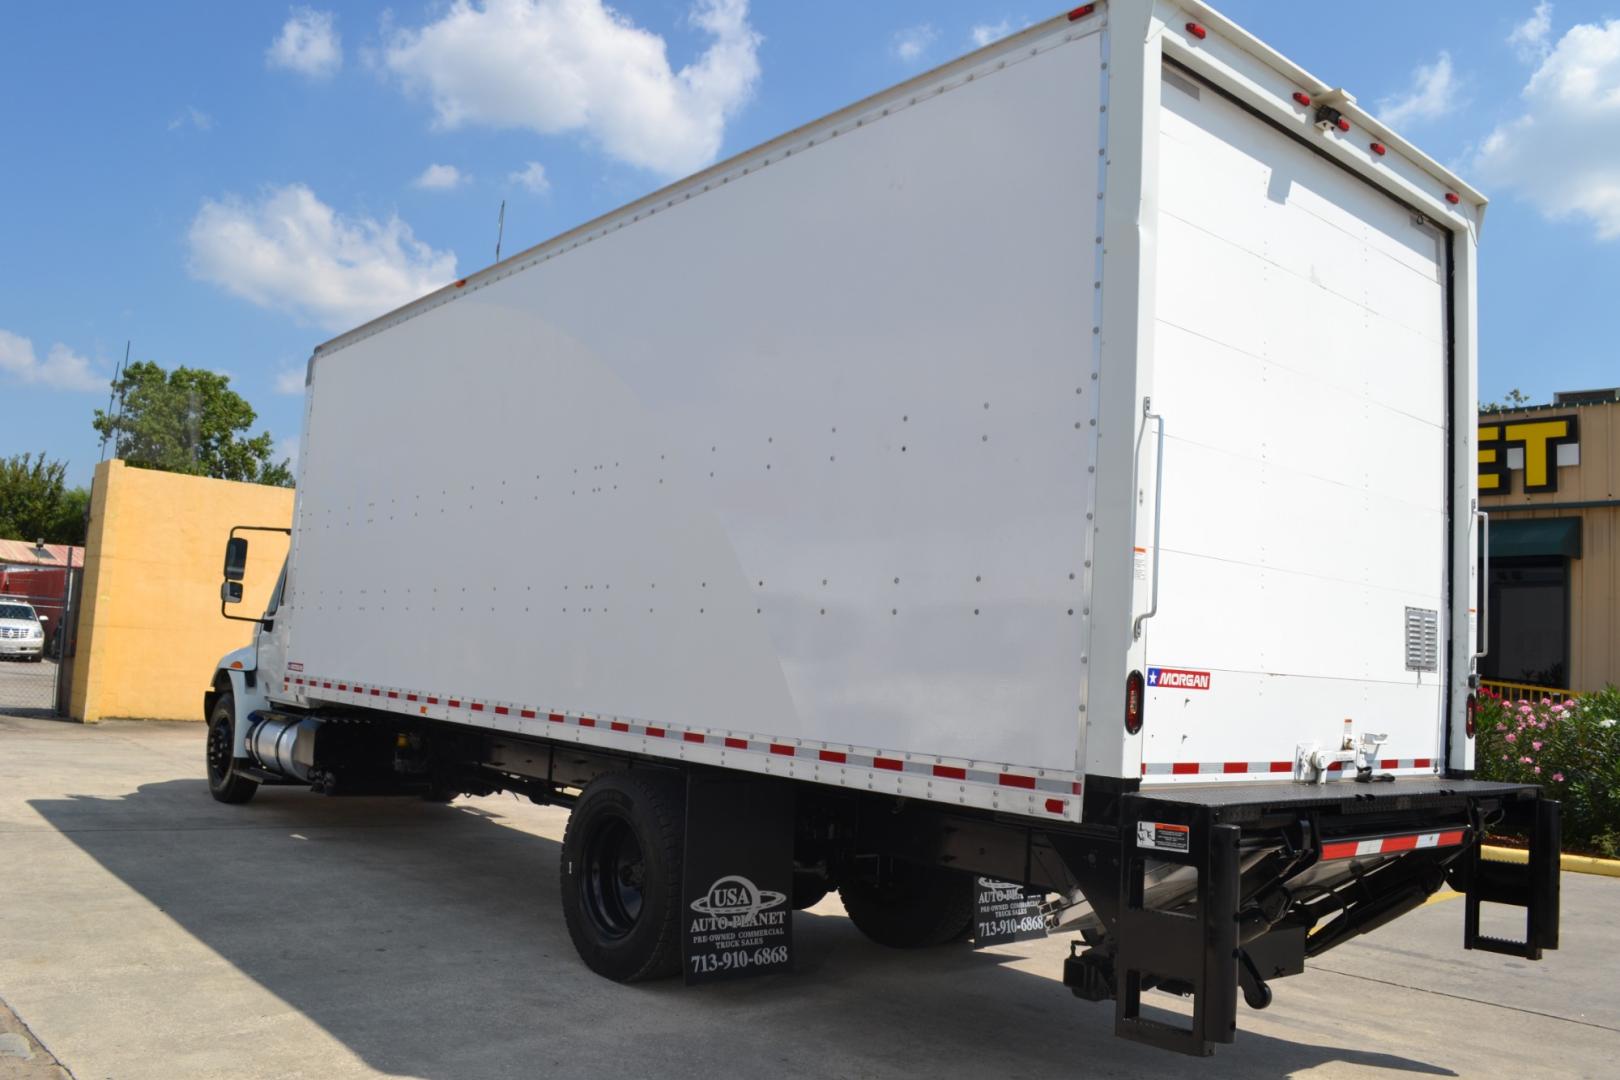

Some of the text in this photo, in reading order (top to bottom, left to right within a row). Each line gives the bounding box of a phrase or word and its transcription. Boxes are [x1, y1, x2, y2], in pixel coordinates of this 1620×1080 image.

[1159, 671, 1209, 688] MORGAN
[714, 888, 750, 907] USA
[690, 911, 786, 933] AUTO-PLANET
[978, 915, 1044, 937] 713-910-6868
[738, 927, 785, 939] COMMERCIAL
[716, 937, 764, 949] TRUCK SALES
[690, 945, 788, 973] 713-910-6868
